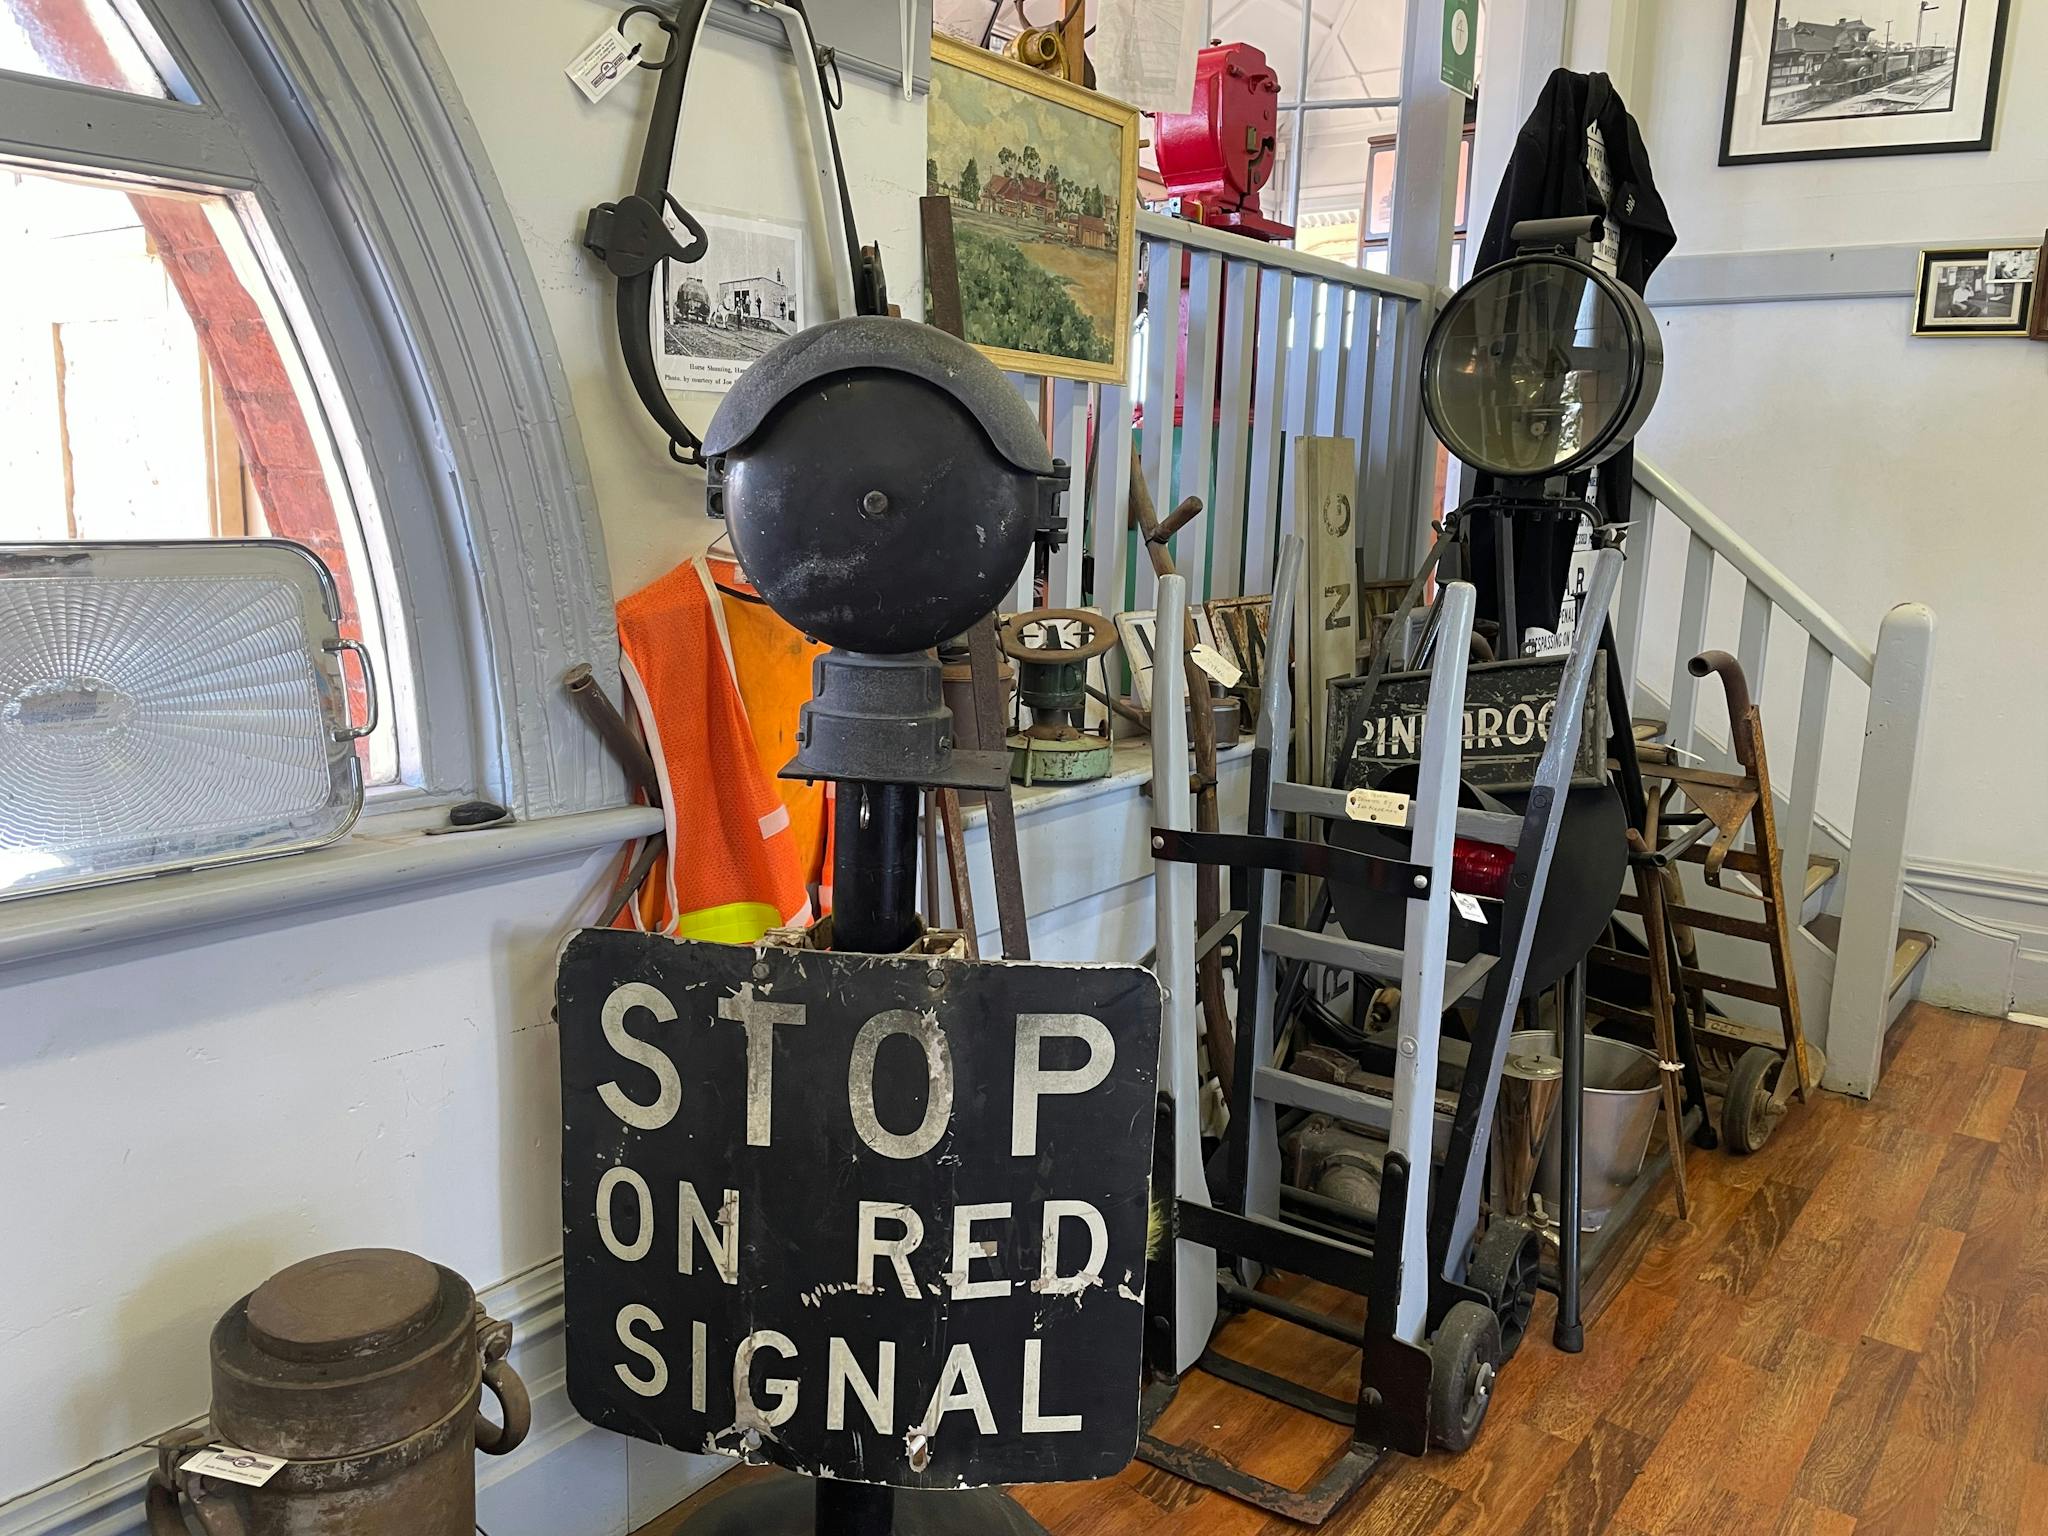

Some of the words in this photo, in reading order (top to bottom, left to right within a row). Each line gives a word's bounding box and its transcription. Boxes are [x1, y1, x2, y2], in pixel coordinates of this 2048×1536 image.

[683, 375, 690, 383] by
[596, 980, 1117, 1160] STOP
[595, 1165, 741, 1286] ON
[856, 1198, 1110, 1301] RED
[613, 1302, 1083, 1436] SIGNAL
